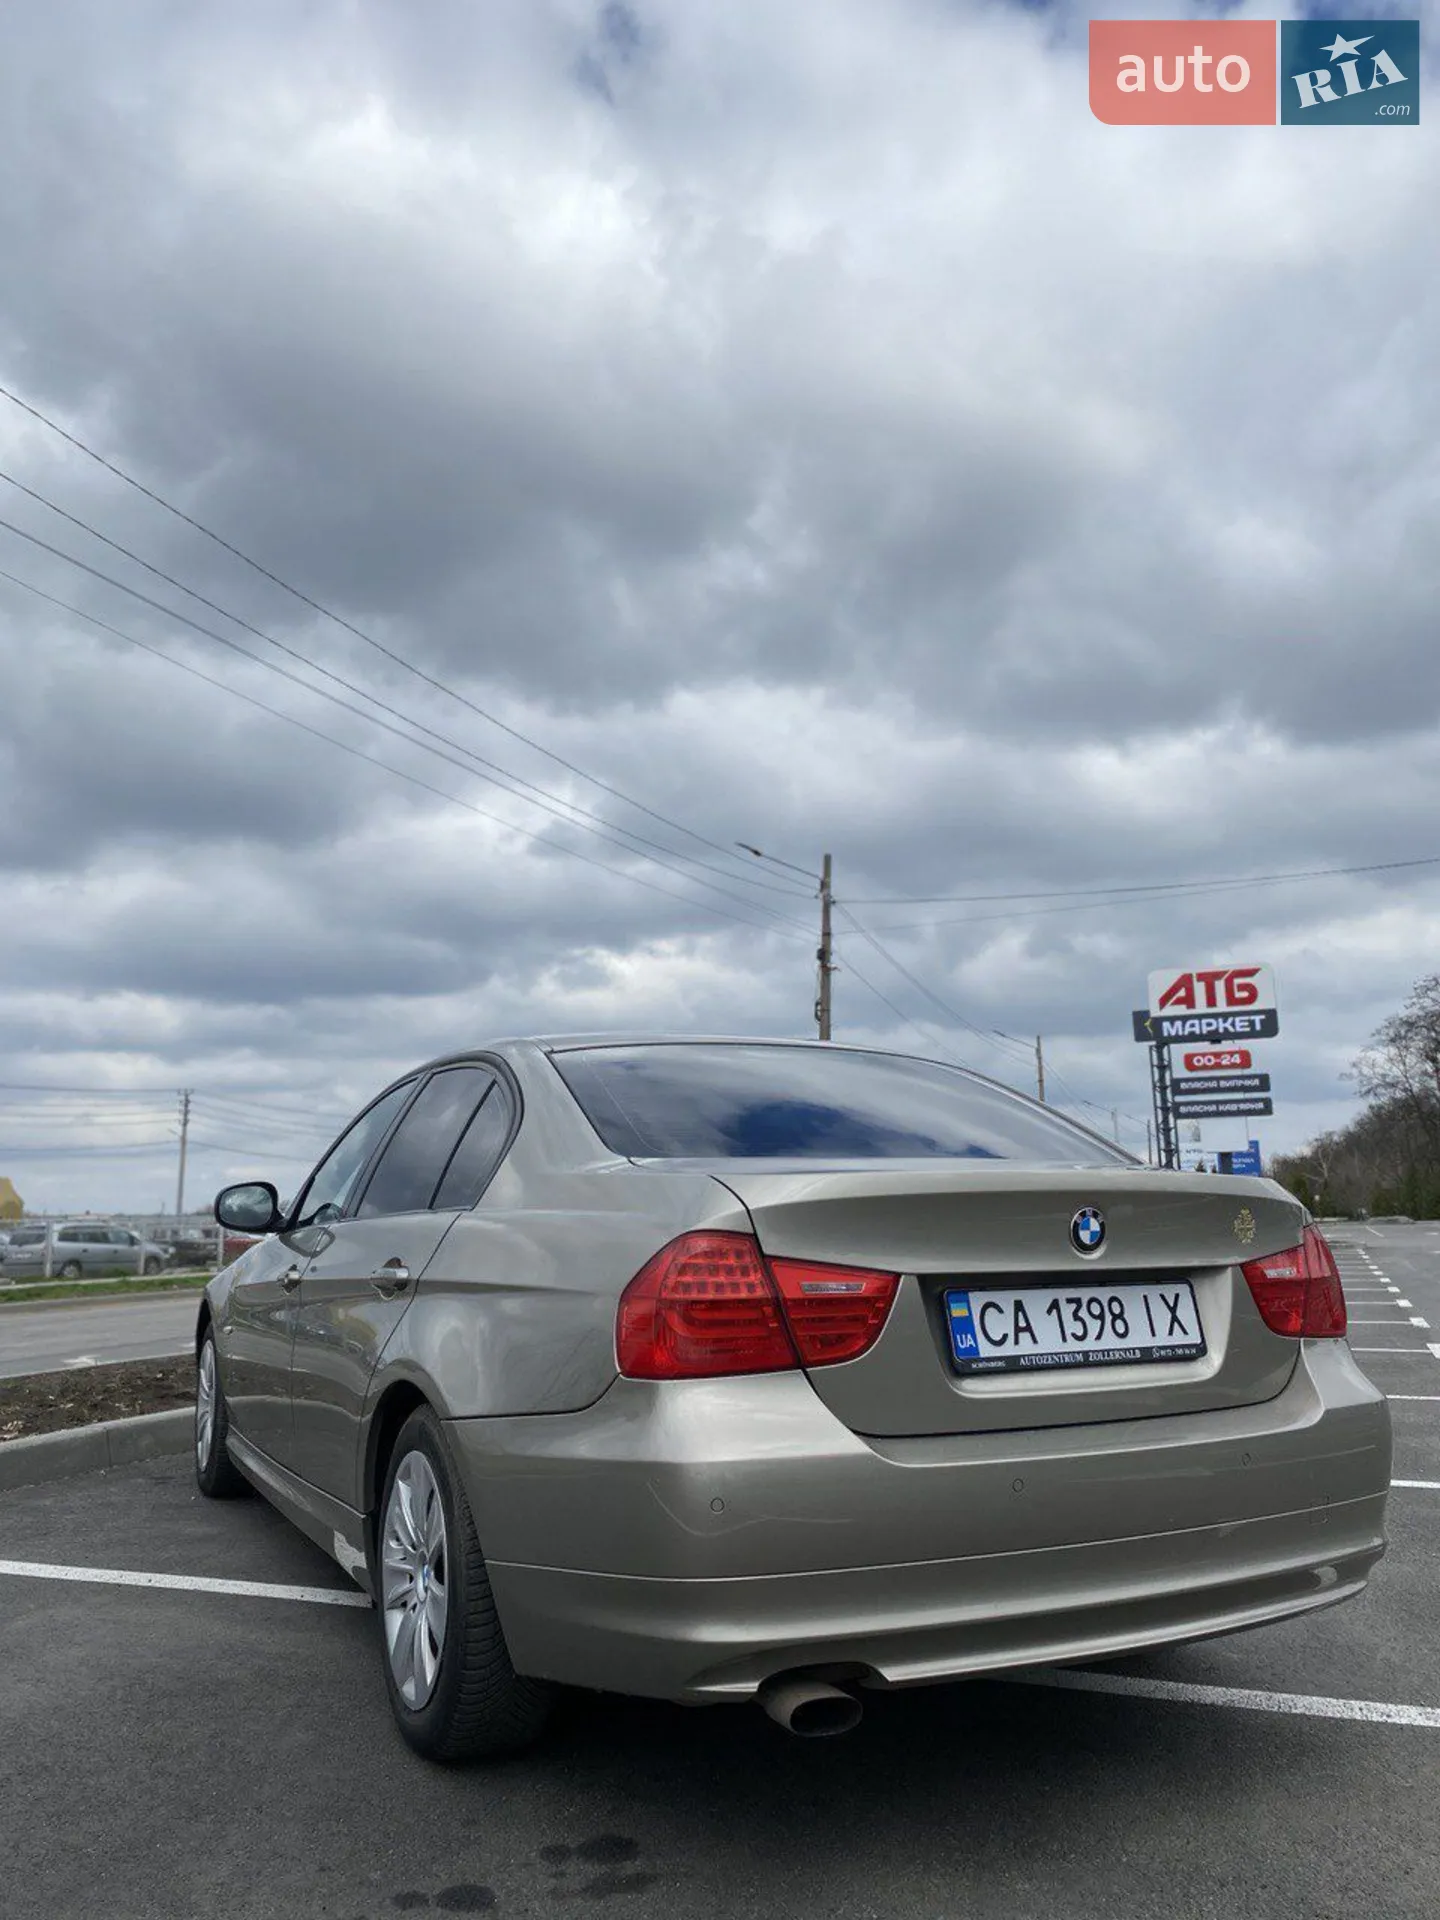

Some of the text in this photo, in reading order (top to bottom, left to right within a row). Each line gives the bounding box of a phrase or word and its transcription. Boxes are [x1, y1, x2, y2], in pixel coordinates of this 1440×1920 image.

[1162, 1015, 1266, 1037] МАРКЕТ
[1192, 1053, 1241, 1067] 00-24
[979, 1292, 1189, 1347] CA 1398 IX
[956, 1334, 977, 1350] UA
[1019, 1352, 1084, 1366] AUTOZENTRUM
[1088, 1349, 1141, 1361] ZOLLERNALB
